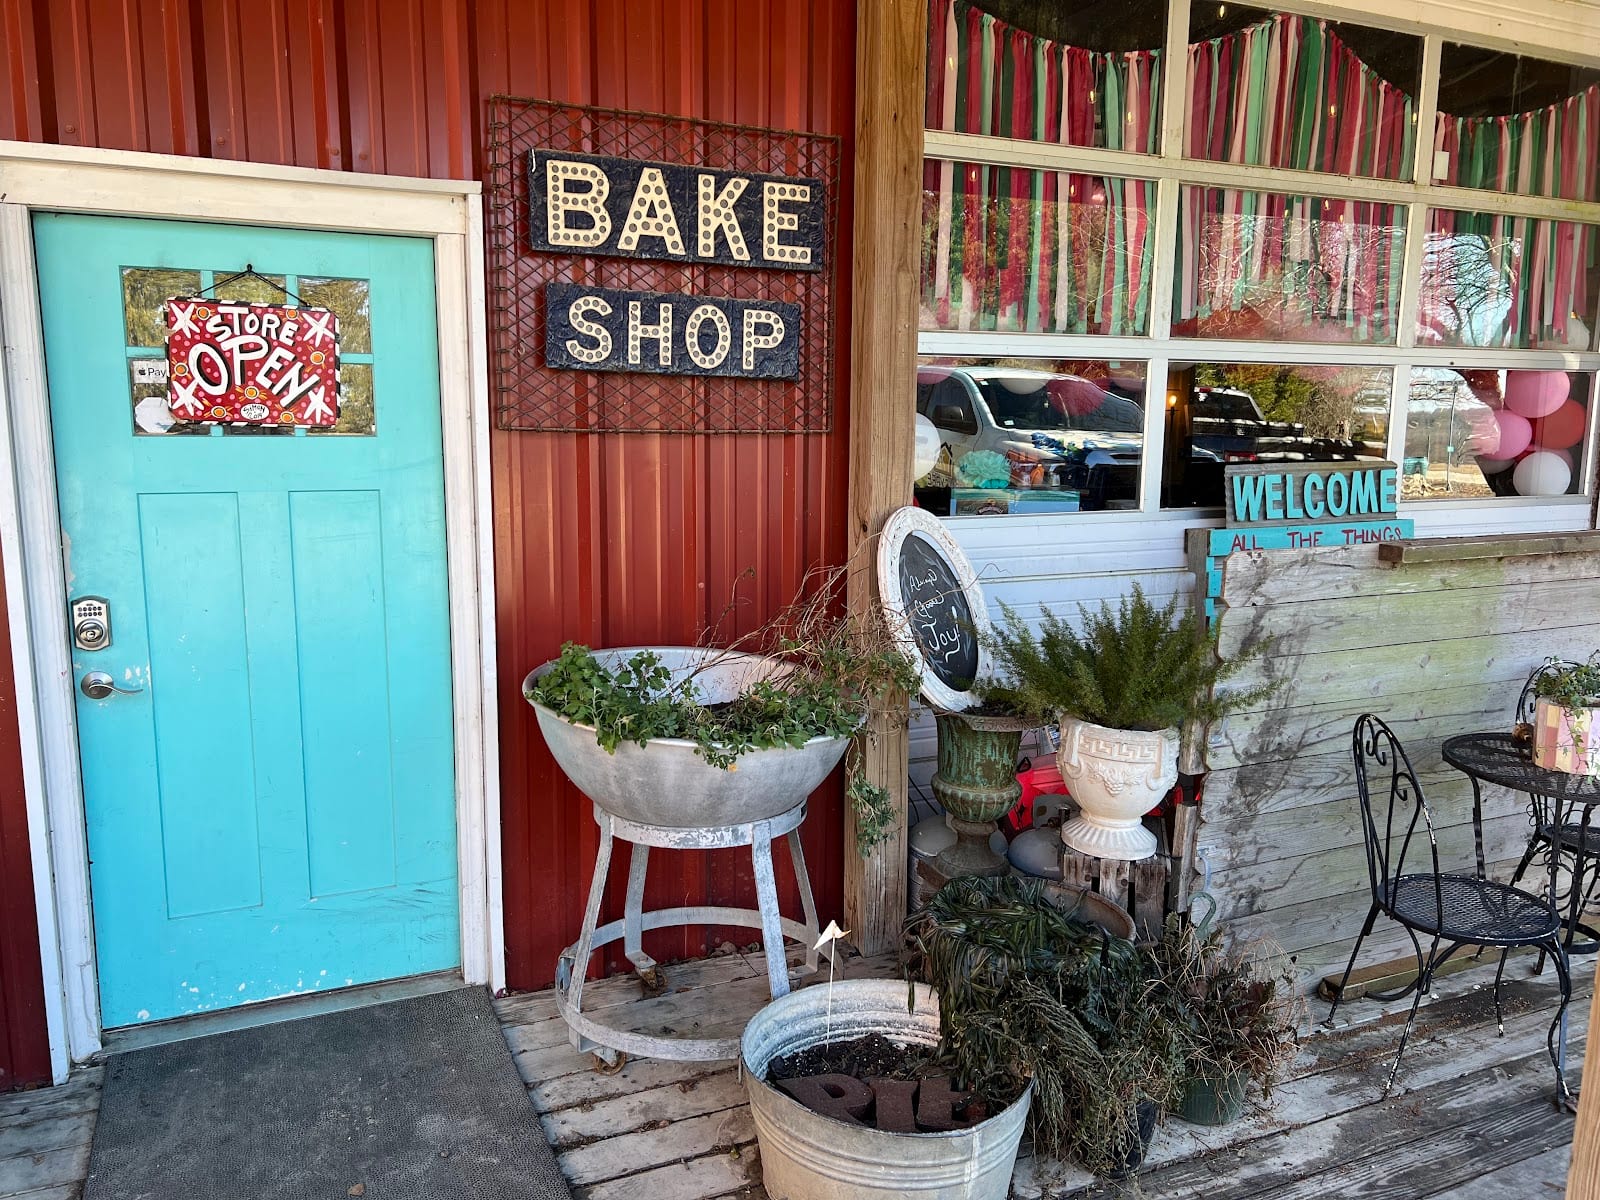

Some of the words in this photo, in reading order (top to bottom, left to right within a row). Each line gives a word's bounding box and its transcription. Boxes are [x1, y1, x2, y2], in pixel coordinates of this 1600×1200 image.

[546, 160, 812, 264] BAKE
[205, 306, 299, 347] STORE
[565, 295, 785, 370] SHOP
[147, 367, 166, 377] Pay
[188, 334, 321, 408] OPEN
[1232, 469, 1397, 522] WELCOME
[1231, 533, 1264, 552] ALL
[1287, 531, 1323, 549] THE
[1342, 526, 1402, 543] THINGS
